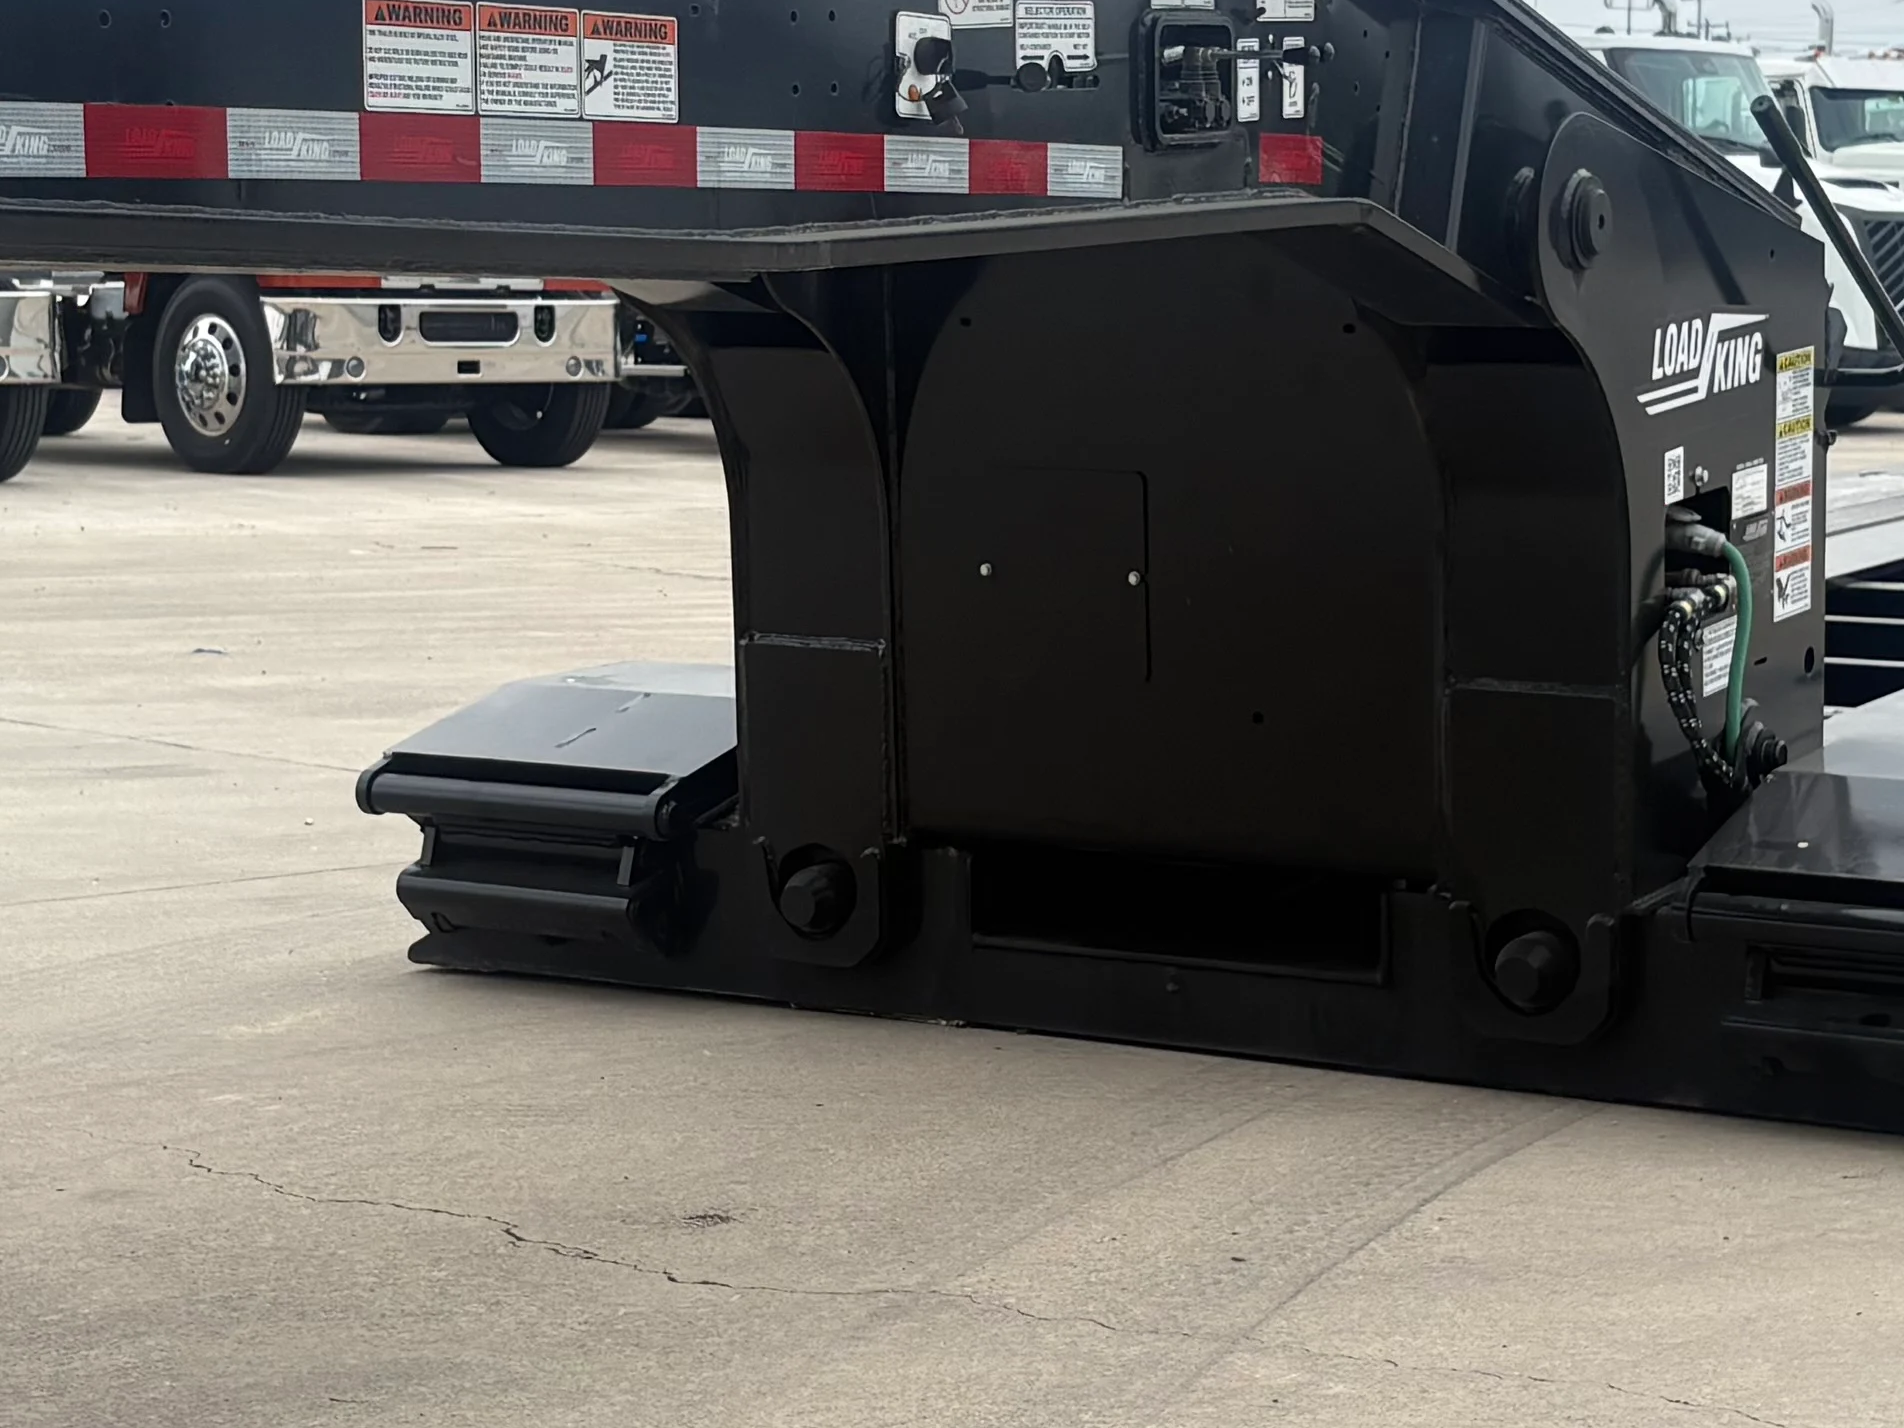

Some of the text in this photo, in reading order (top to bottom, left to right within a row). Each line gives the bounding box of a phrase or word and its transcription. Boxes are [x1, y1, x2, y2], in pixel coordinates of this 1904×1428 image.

[387, 4, 463, 26] WARNING
[499, 11, 569, 32] WARNING
[602, 19, 668, 40] WARNING
[14, 135, 48, 154] KING
[264, 131, 294, 147] LOAD
[300, 141, 329, 159] KING
[1652, 318, 1704, 381] LOAD
[1713, 332, 1763, 394] KING
